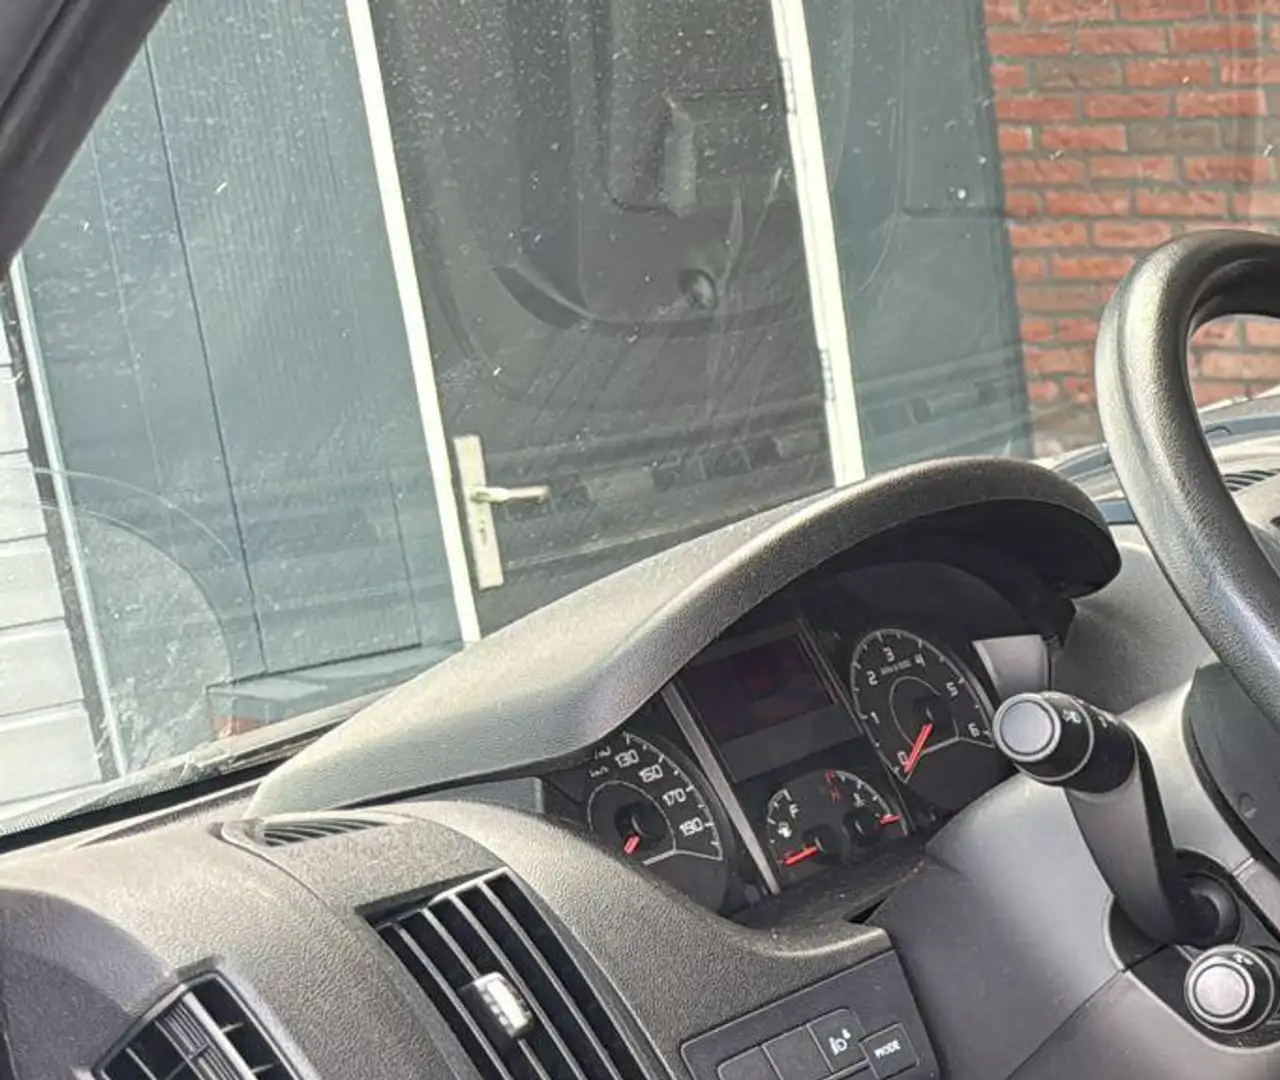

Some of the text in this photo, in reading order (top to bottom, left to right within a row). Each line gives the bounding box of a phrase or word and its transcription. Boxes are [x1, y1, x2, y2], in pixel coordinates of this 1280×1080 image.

[883, 646, 895, 662] 3
[866, 670, 878, 686] 2
[614, 749, 639, 768] 130
[662, 788, 686, 806] 170
[679, 817, 703, 836] 190
